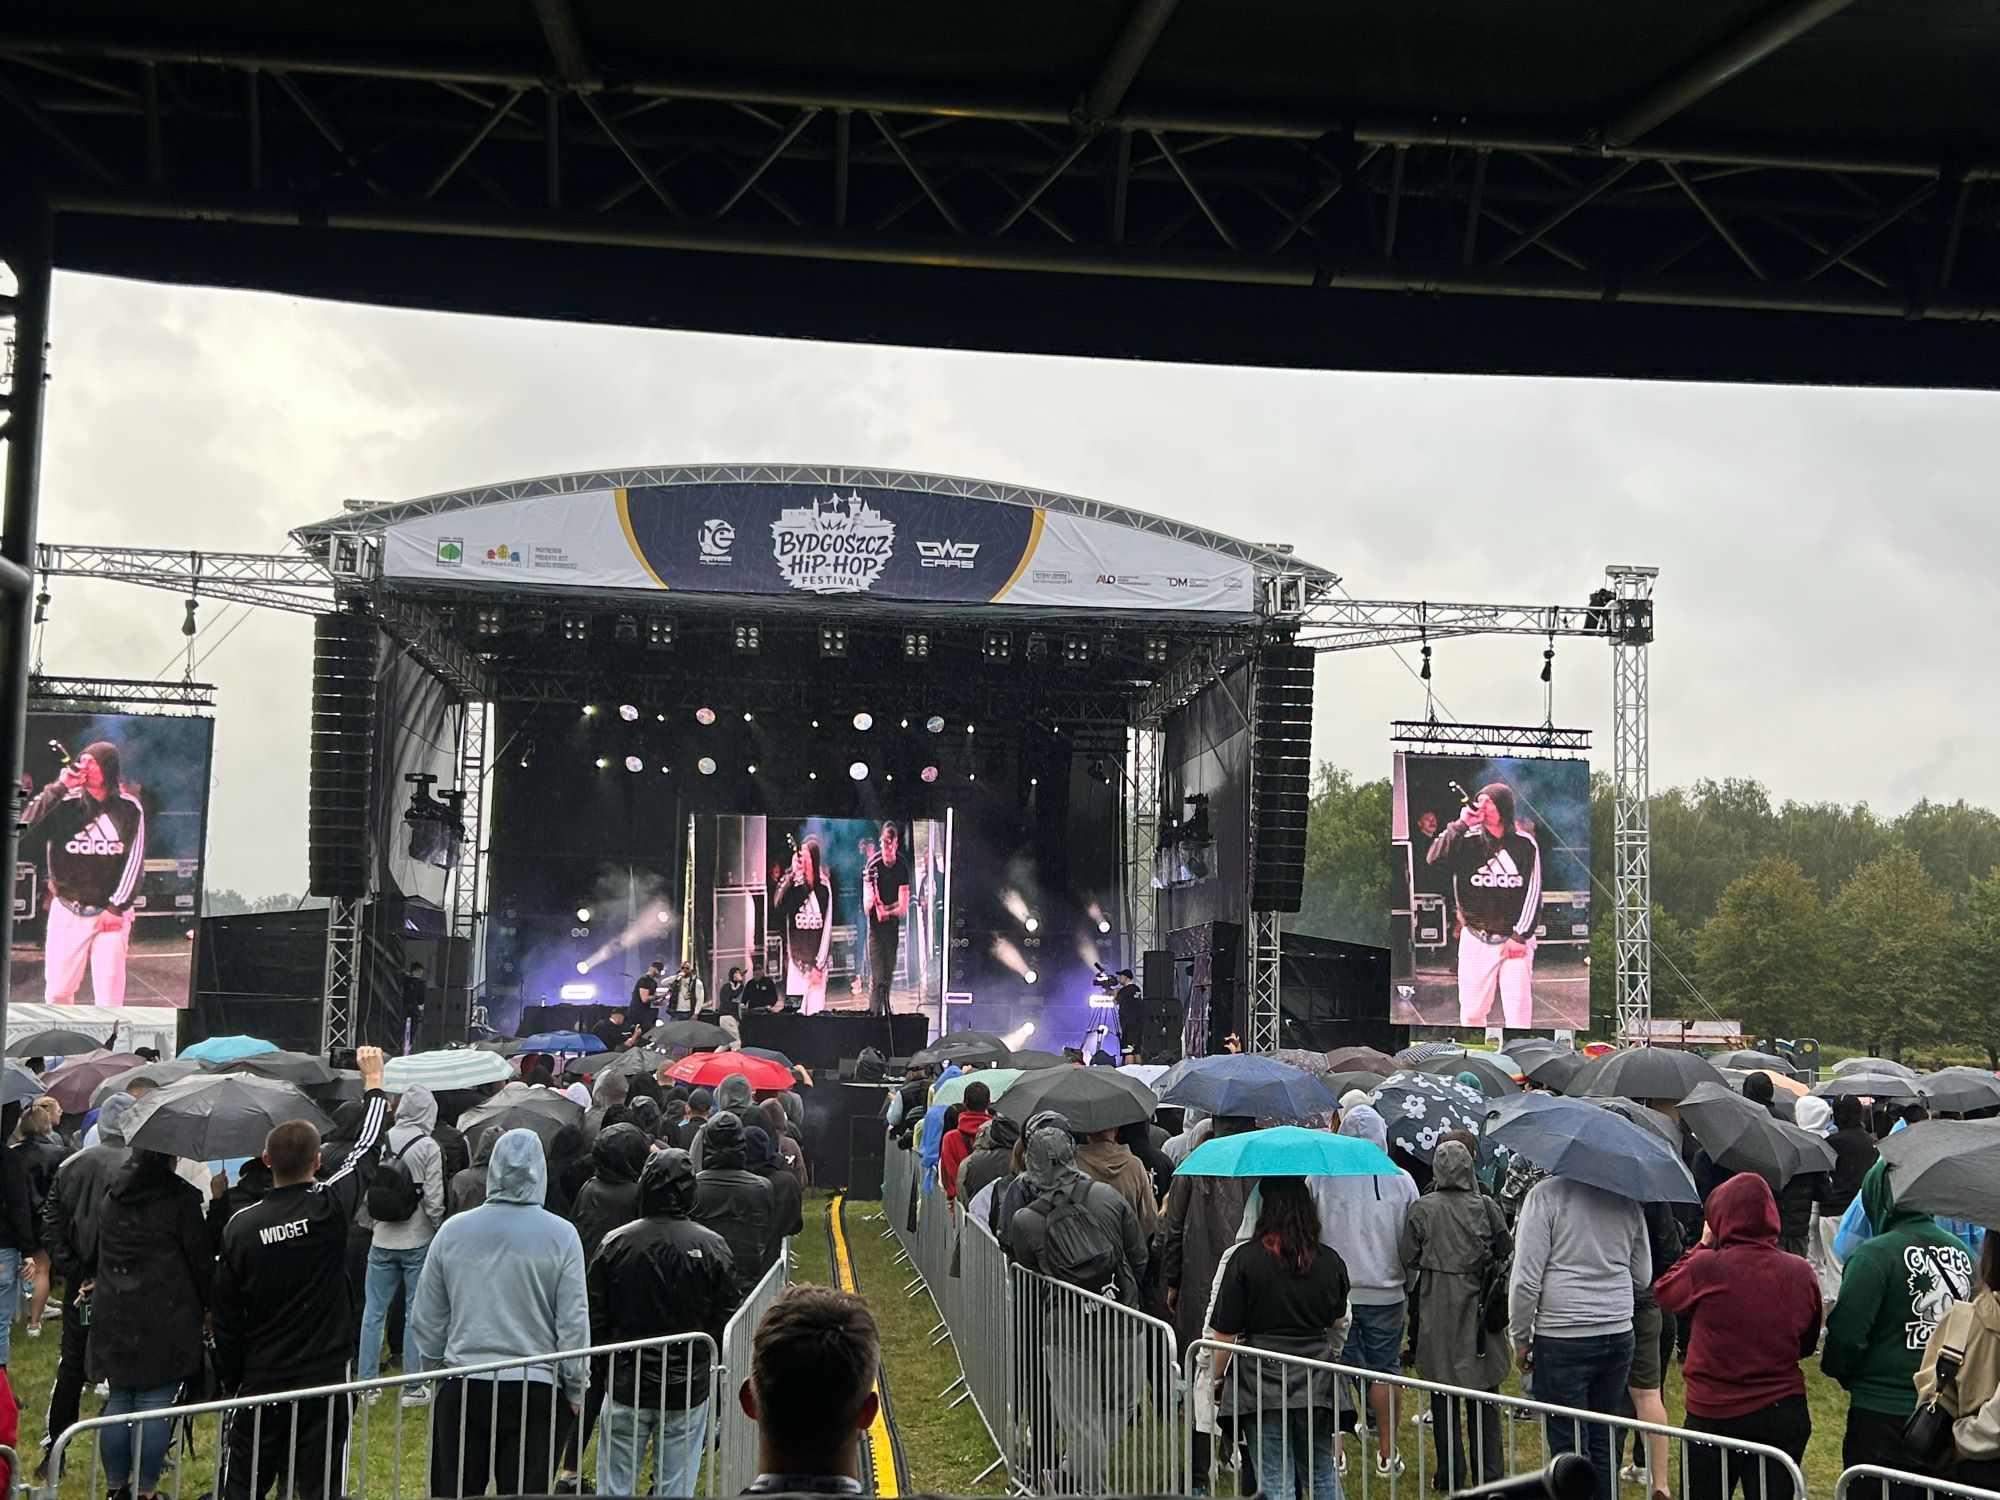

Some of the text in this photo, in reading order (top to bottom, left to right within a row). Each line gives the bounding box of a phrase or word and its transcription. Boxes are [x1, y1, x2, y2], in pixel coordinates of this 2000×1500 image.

[778, 531, 889, 556] BYDGOSZCZ
[920, 558, 975, 569] CARS
[802, 575, 862, 587] FESTIVAL
[260, 1218, 309, 1245] WIDGET
